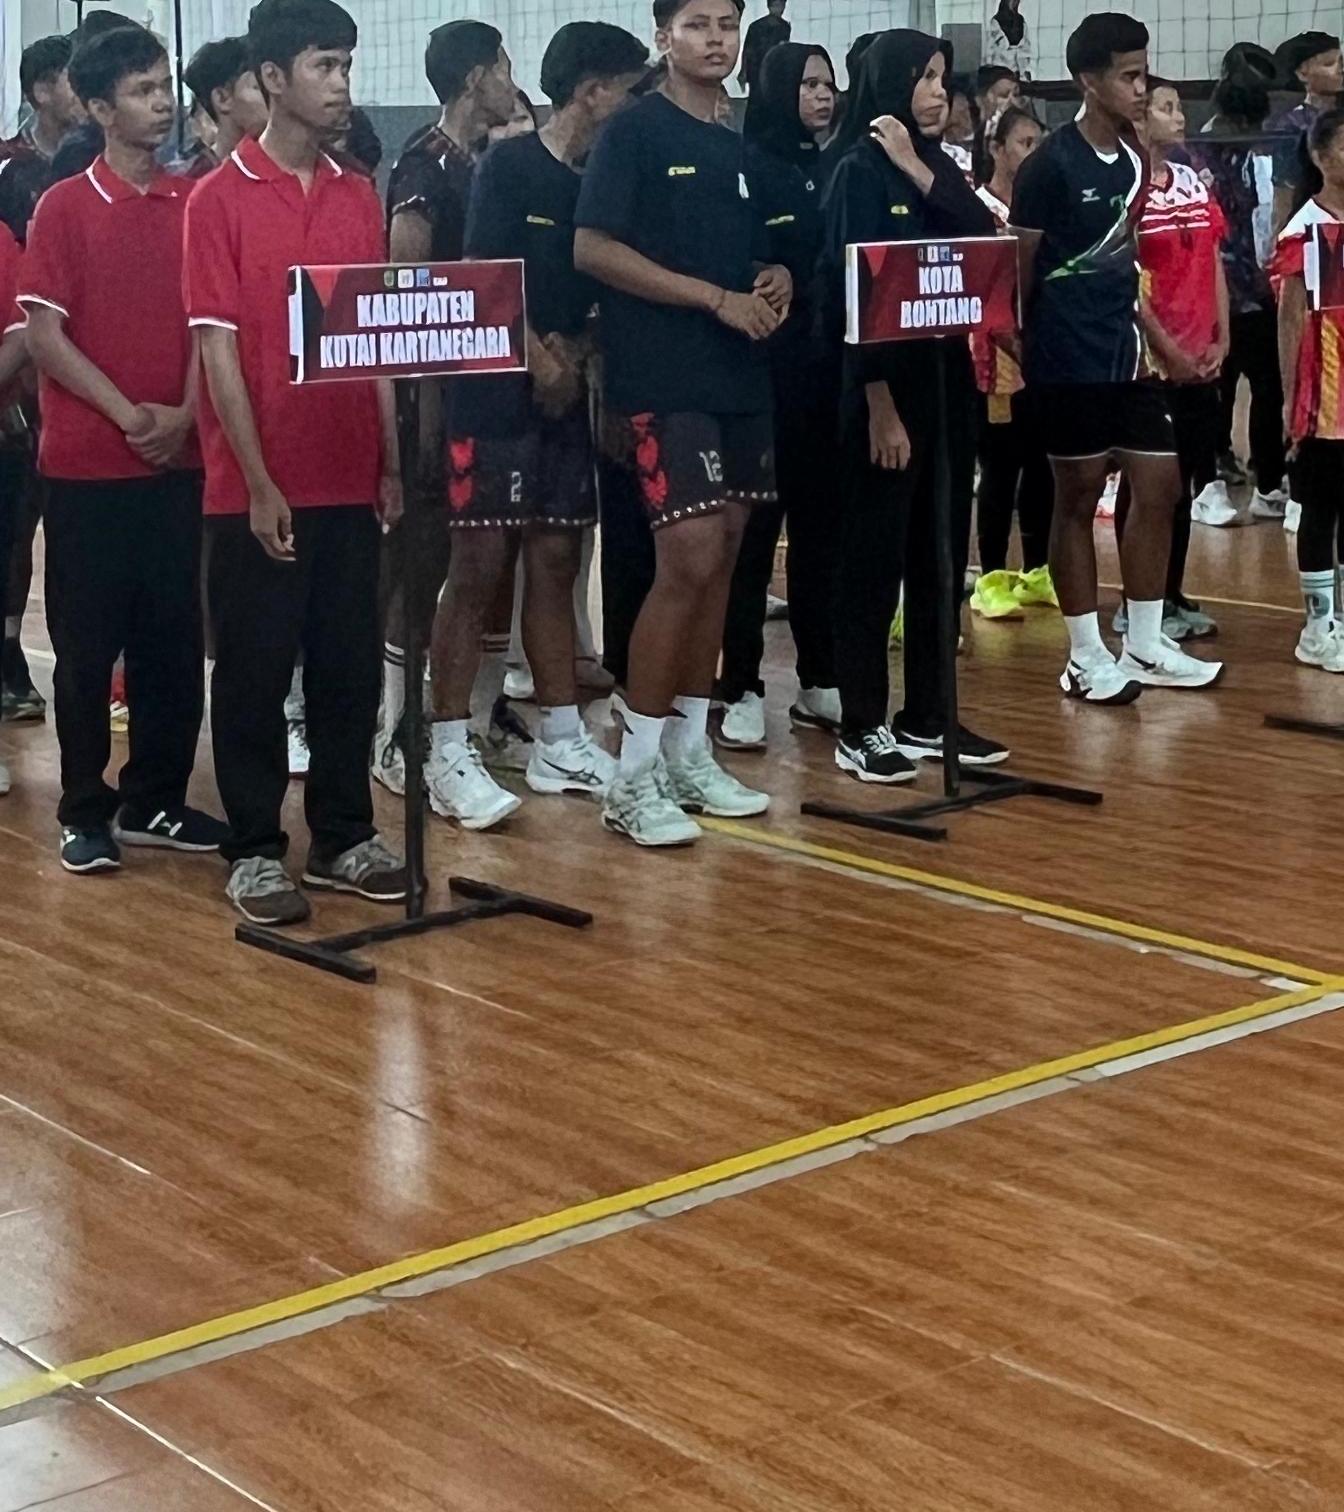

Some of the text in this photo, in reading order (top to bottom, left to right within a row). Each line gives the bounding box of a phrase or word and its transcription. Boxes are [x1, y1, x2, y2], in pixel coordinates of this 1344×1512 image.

[918, 265, 964, 295] KOTA
[356, 289, 475, 328] KABUPATEN
[899, 296, 983, 329] BONTANG
[320, 325, 511, 369] KUTAI KARTANEGARA
